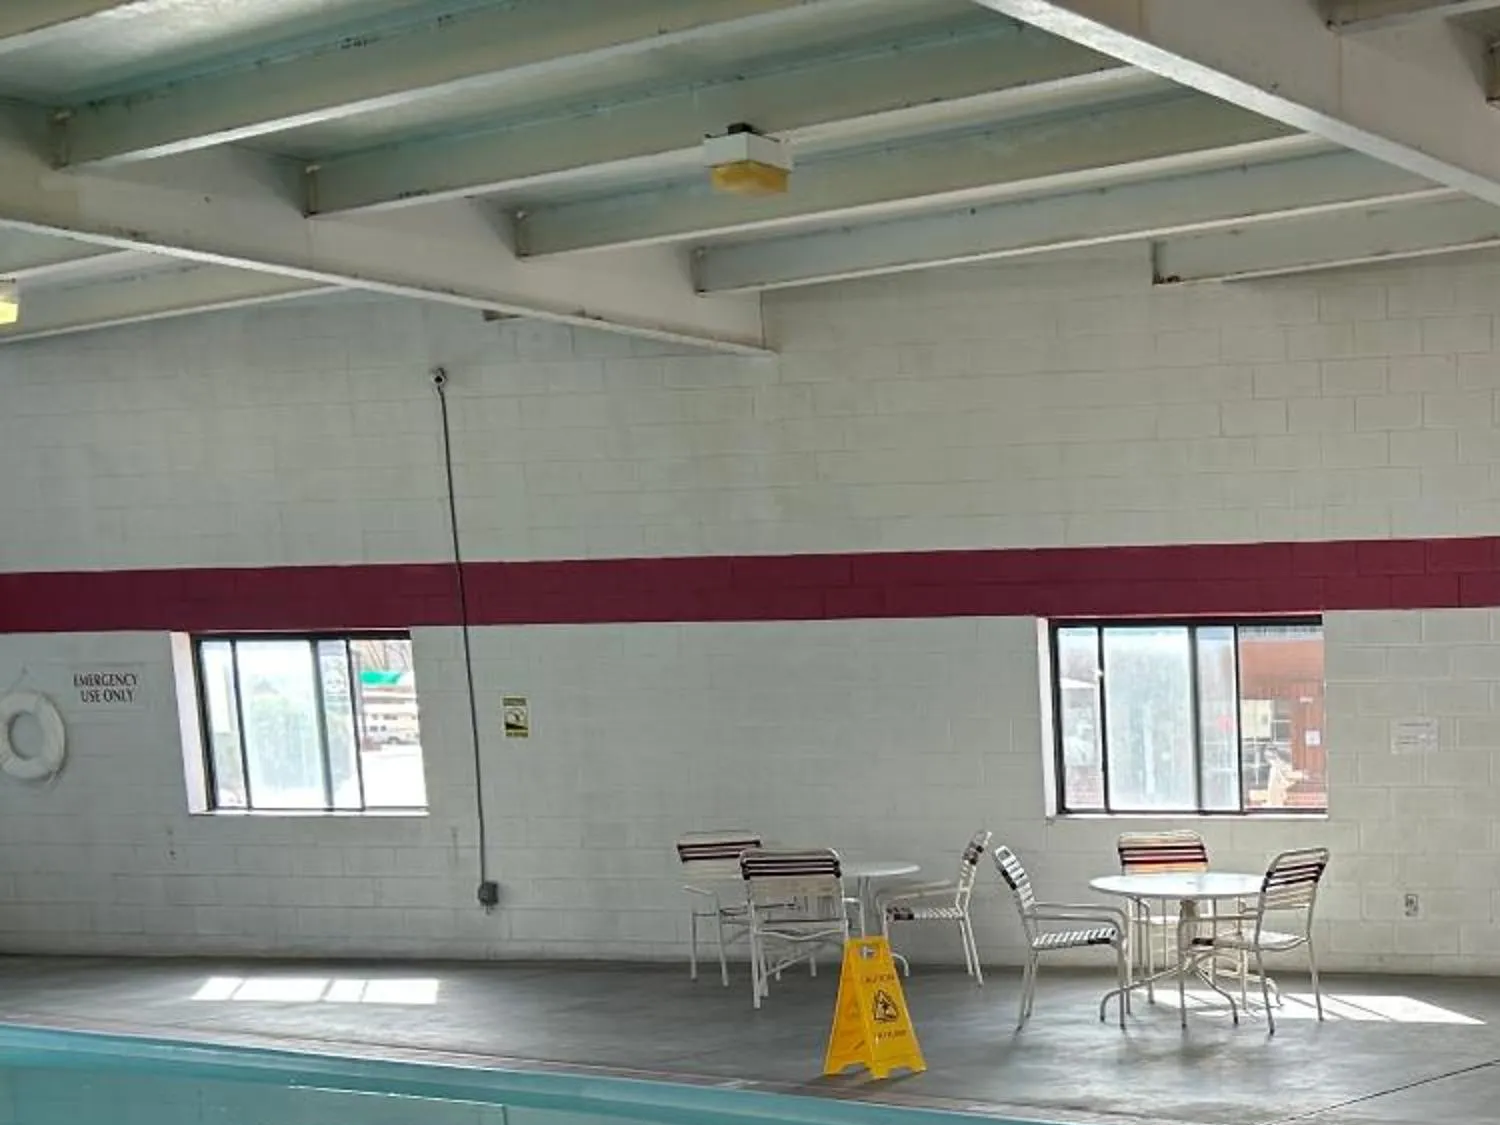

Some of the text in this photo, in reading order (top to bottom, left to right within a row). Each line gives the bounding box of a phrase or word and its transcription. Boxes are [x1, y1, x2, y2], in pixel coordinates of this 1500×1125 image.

[73, 673, 137, 687] EMERGENCY
[81, 688, 133, 703] USE ONLY
